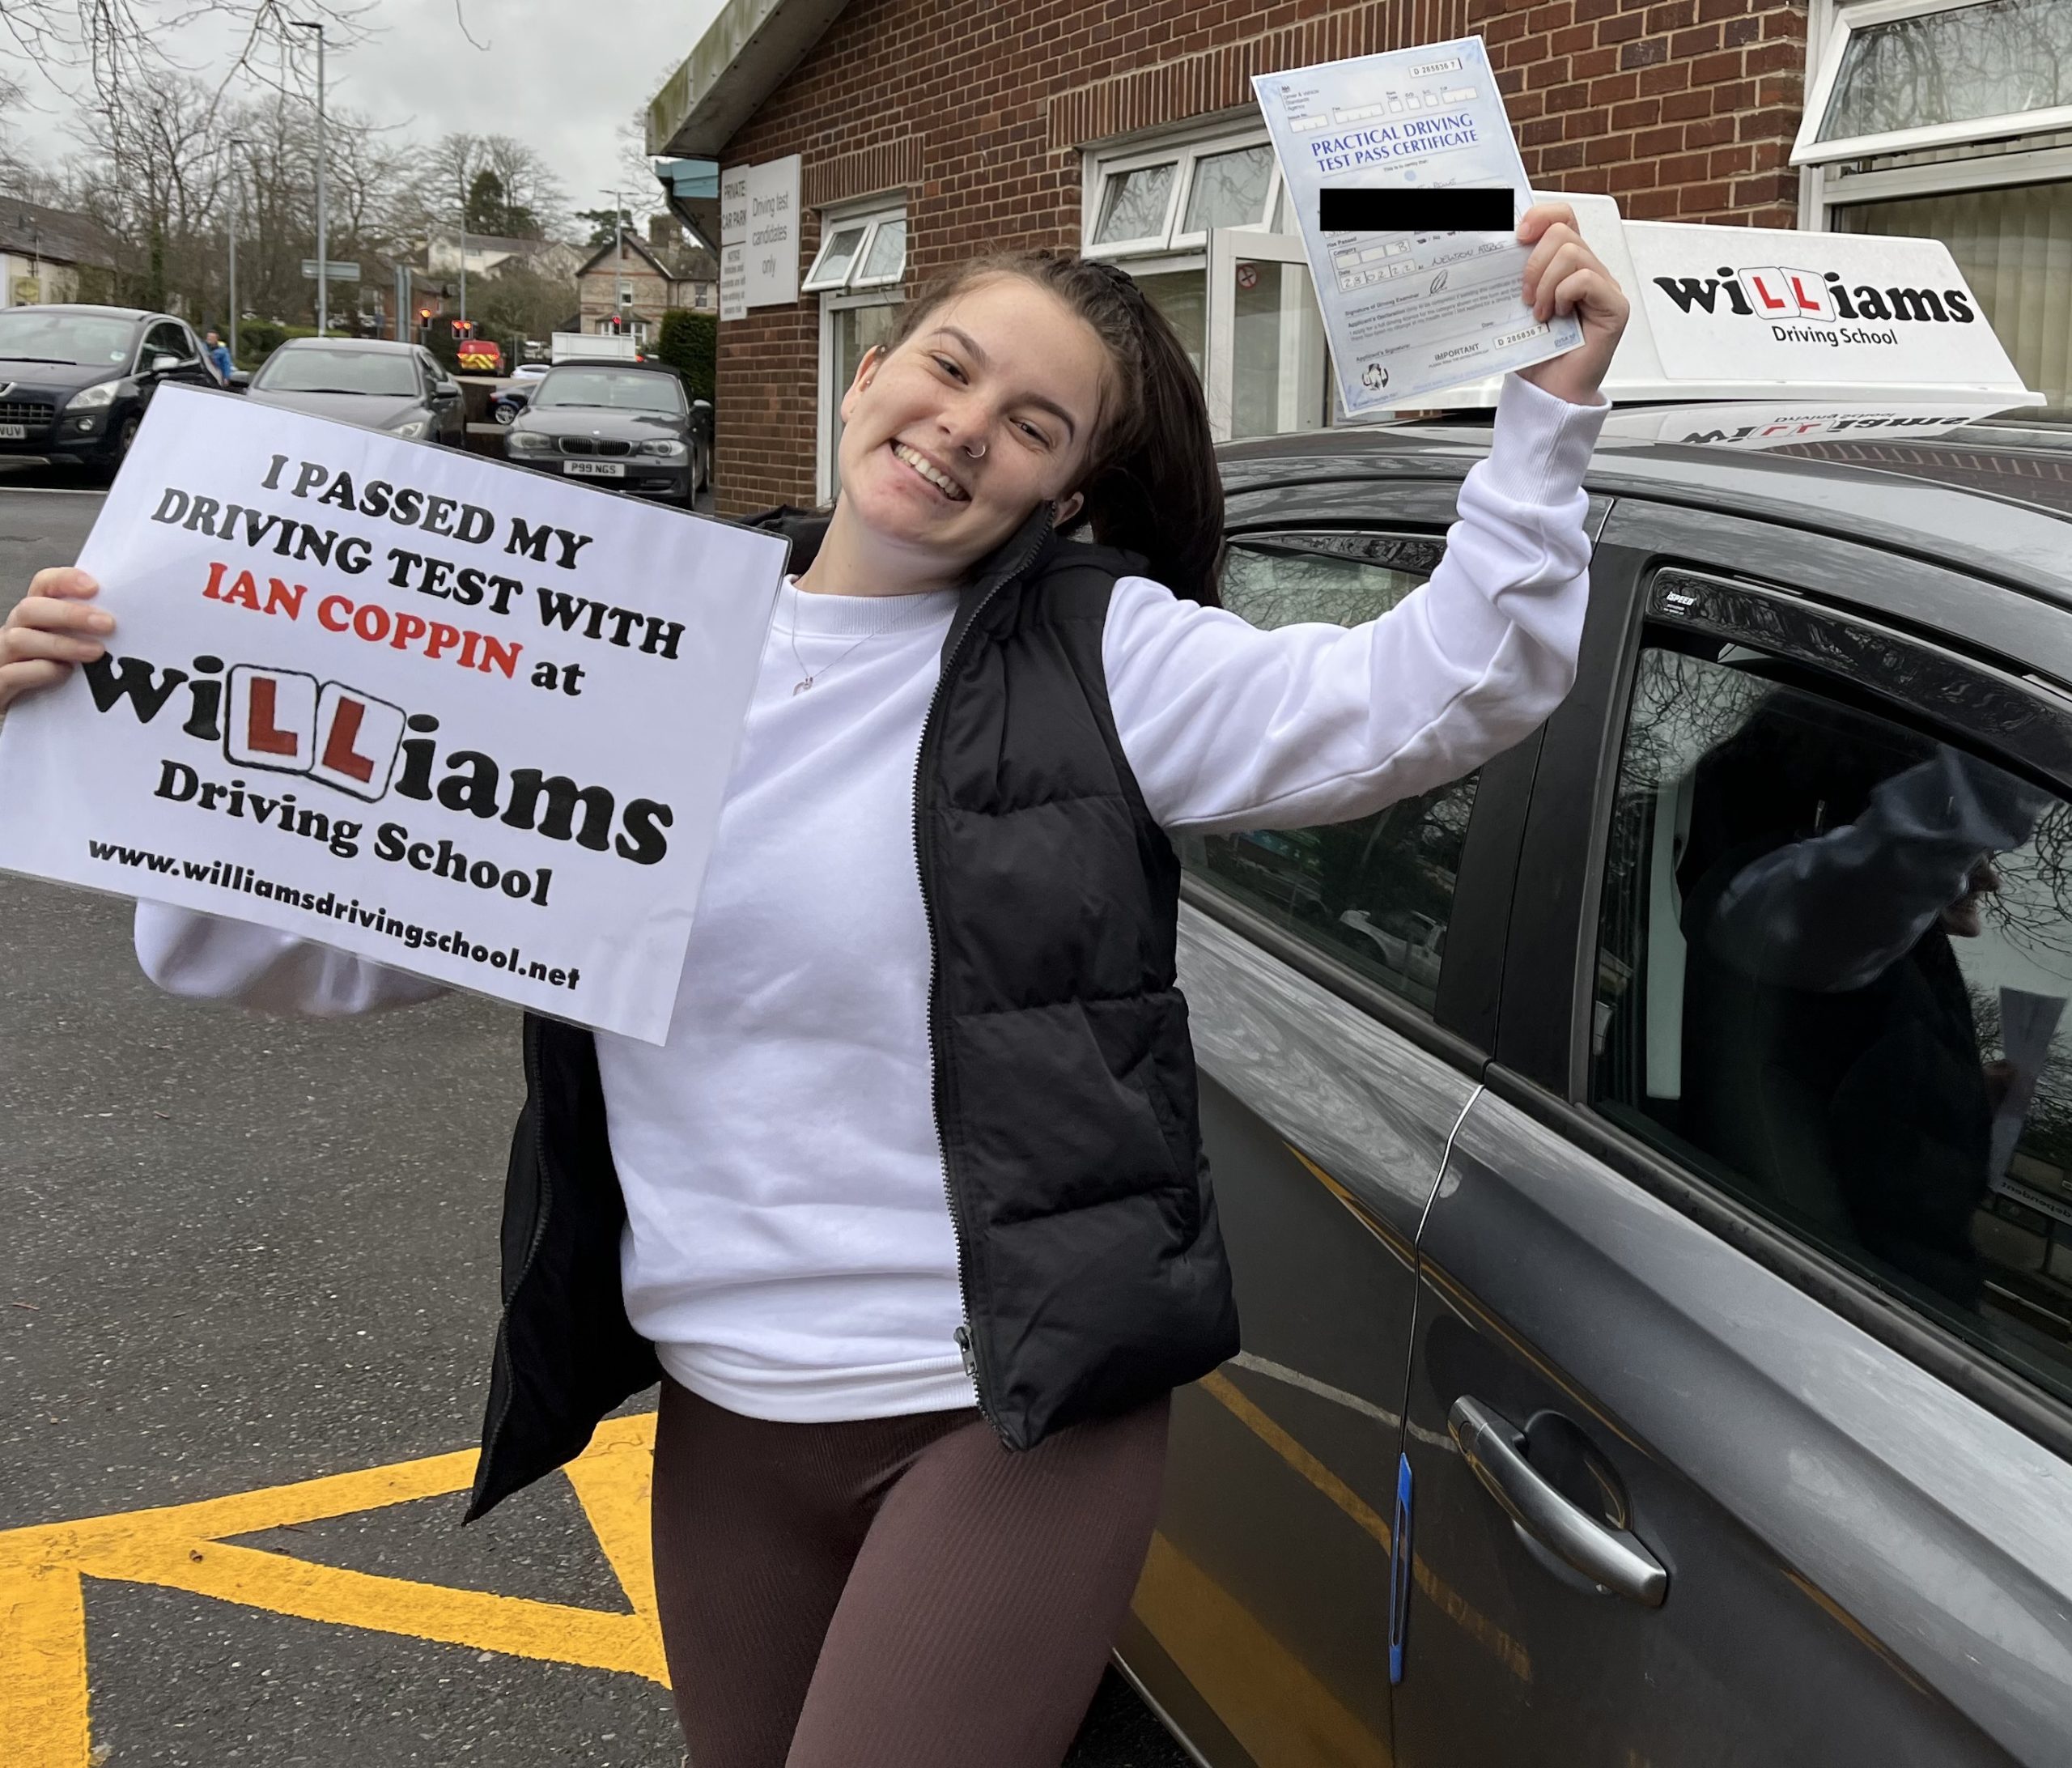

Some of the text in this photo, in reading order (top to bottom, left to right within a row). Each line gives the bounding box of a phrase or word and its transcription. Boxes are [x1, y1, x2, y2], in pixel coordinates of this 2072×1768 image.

[1311, 112, 1473, 157] PRACTICAL DRIVING
[1316, 127, 1479, 172] TEST PASS CERTIFICATE
[724, 181, 745, 198] PRIVATE
[752, 191, 789, 218] Driving test
[722, 209, 747, 231] CAR PARK
[752, 224, 788, 247] candidates
[762, 253, 777, 278] only
[1772, 325, 1898, 347] Driving School
[1434, 342, 1480, 362] IMPORTANT
[1497, 338, 1505, 346] D
[571, 462, 616, 474] P99 NGS
[261, 455, 593, 570] I PASSED MY
[151, 488, 686, 660] DRIVING TEST WITH
[202, 562, 586, 696] IAN COPPIN at
[154, 759, 553, 907] Driving School
[87, 838, 580, 991] www.williamsdrivingschool.net
